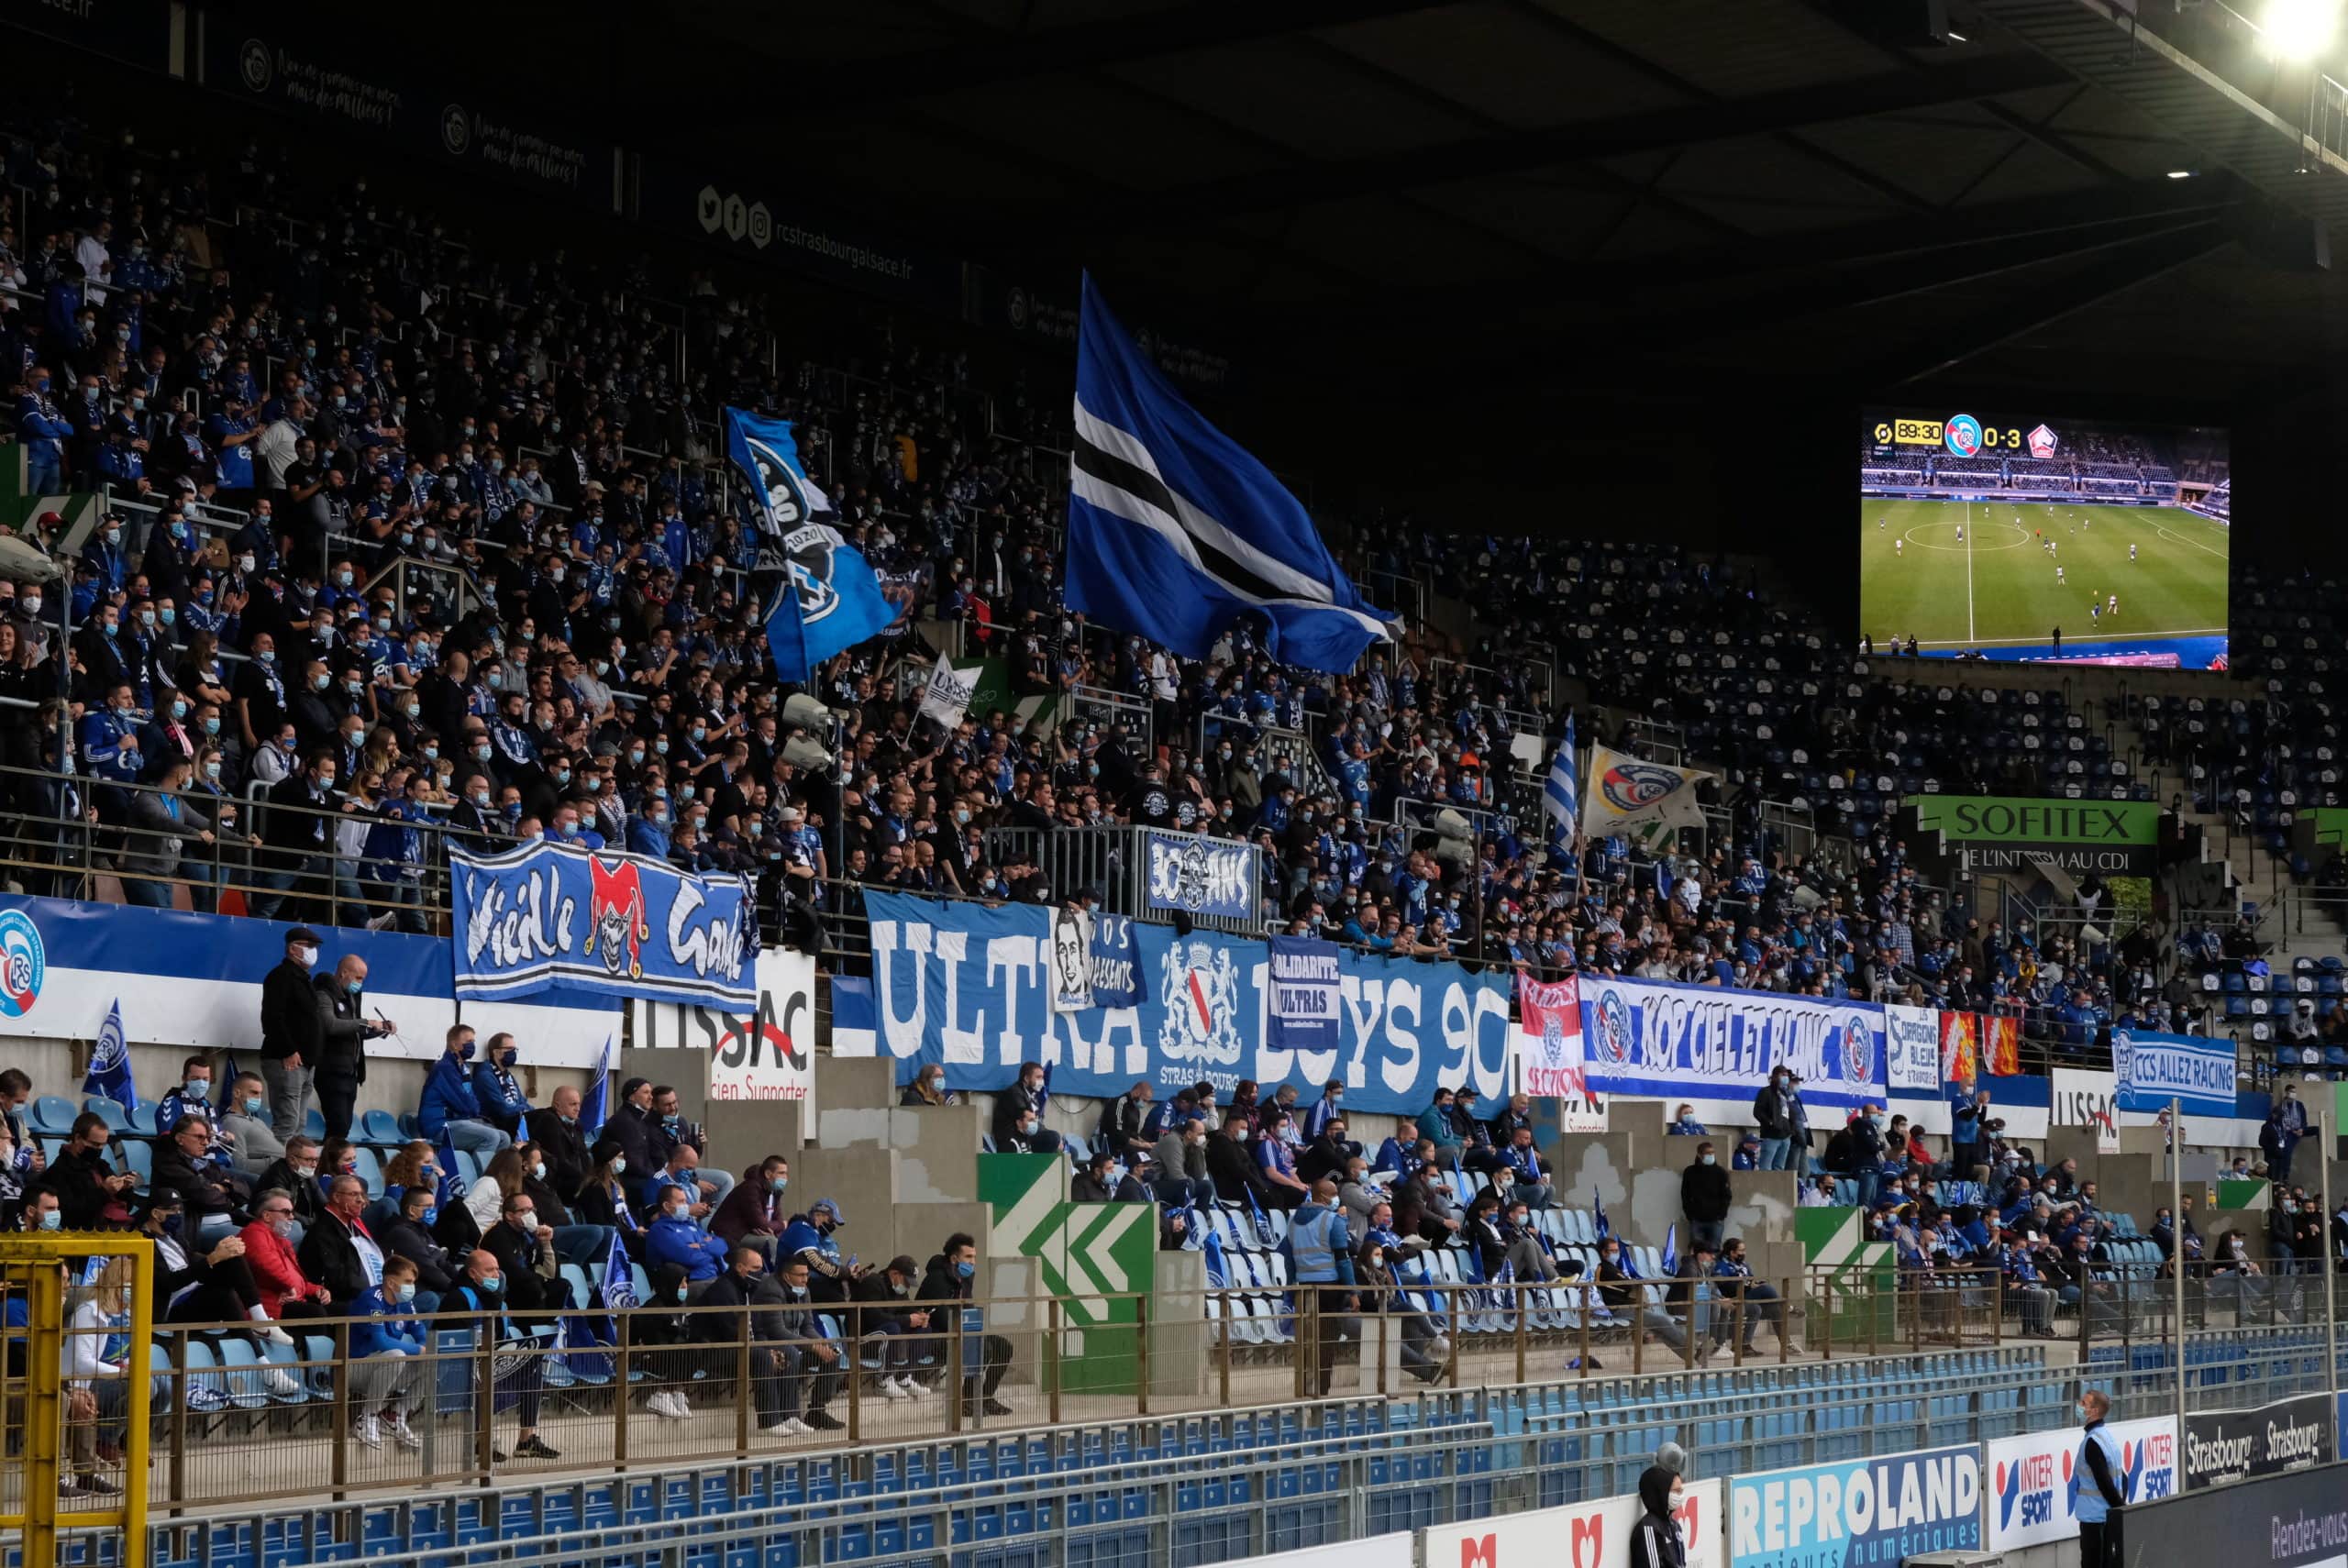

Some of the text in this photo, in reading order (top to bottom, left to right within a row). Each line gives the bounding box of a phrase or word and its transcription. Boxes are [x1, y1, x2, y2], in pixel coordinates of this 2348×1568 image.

[778, 223, 913, 279] rcstrasbourgalsace.fr
[1898, 423, 1941, 440] 89:30
[1956, 803, 2130, 838] SOFITEX
[1752, 865, 1765, 878] 11
[1983, 850, 2064, 867] L'INTM
[2067, 852, 2093, 869] AU
[2098, 852, 2129, 870] CDI
[1279, 989, 1327, 1013] ULTRAS
[1437, 982, 1510, 1100] 90
[1641, 994, 1833, 1083] KOP CIEL ET BLANC
[1527, 1066, 1585, 1096] SECTION
[2135, 1054, 2233, 1091] CCS ALLEZ RACING
[2144, 1433, 2173, 1468] INTER
[2187, 1425, 2253, 1476] Strasbourg
[2267, 1415, 2319, 1462] Strasbourg
[2021, 1453, 2054, 1493] INTER
[2145, 1467, 2173, 1501] SPORT
[1733, 1454, 1979, 1557] REPROLAND
[2021, 1490, 2054, 1527] SPORT
[1855, 1522, 1978, 1565] numériques
[2272, 1507, 2348, 1559] Rendez-vous
